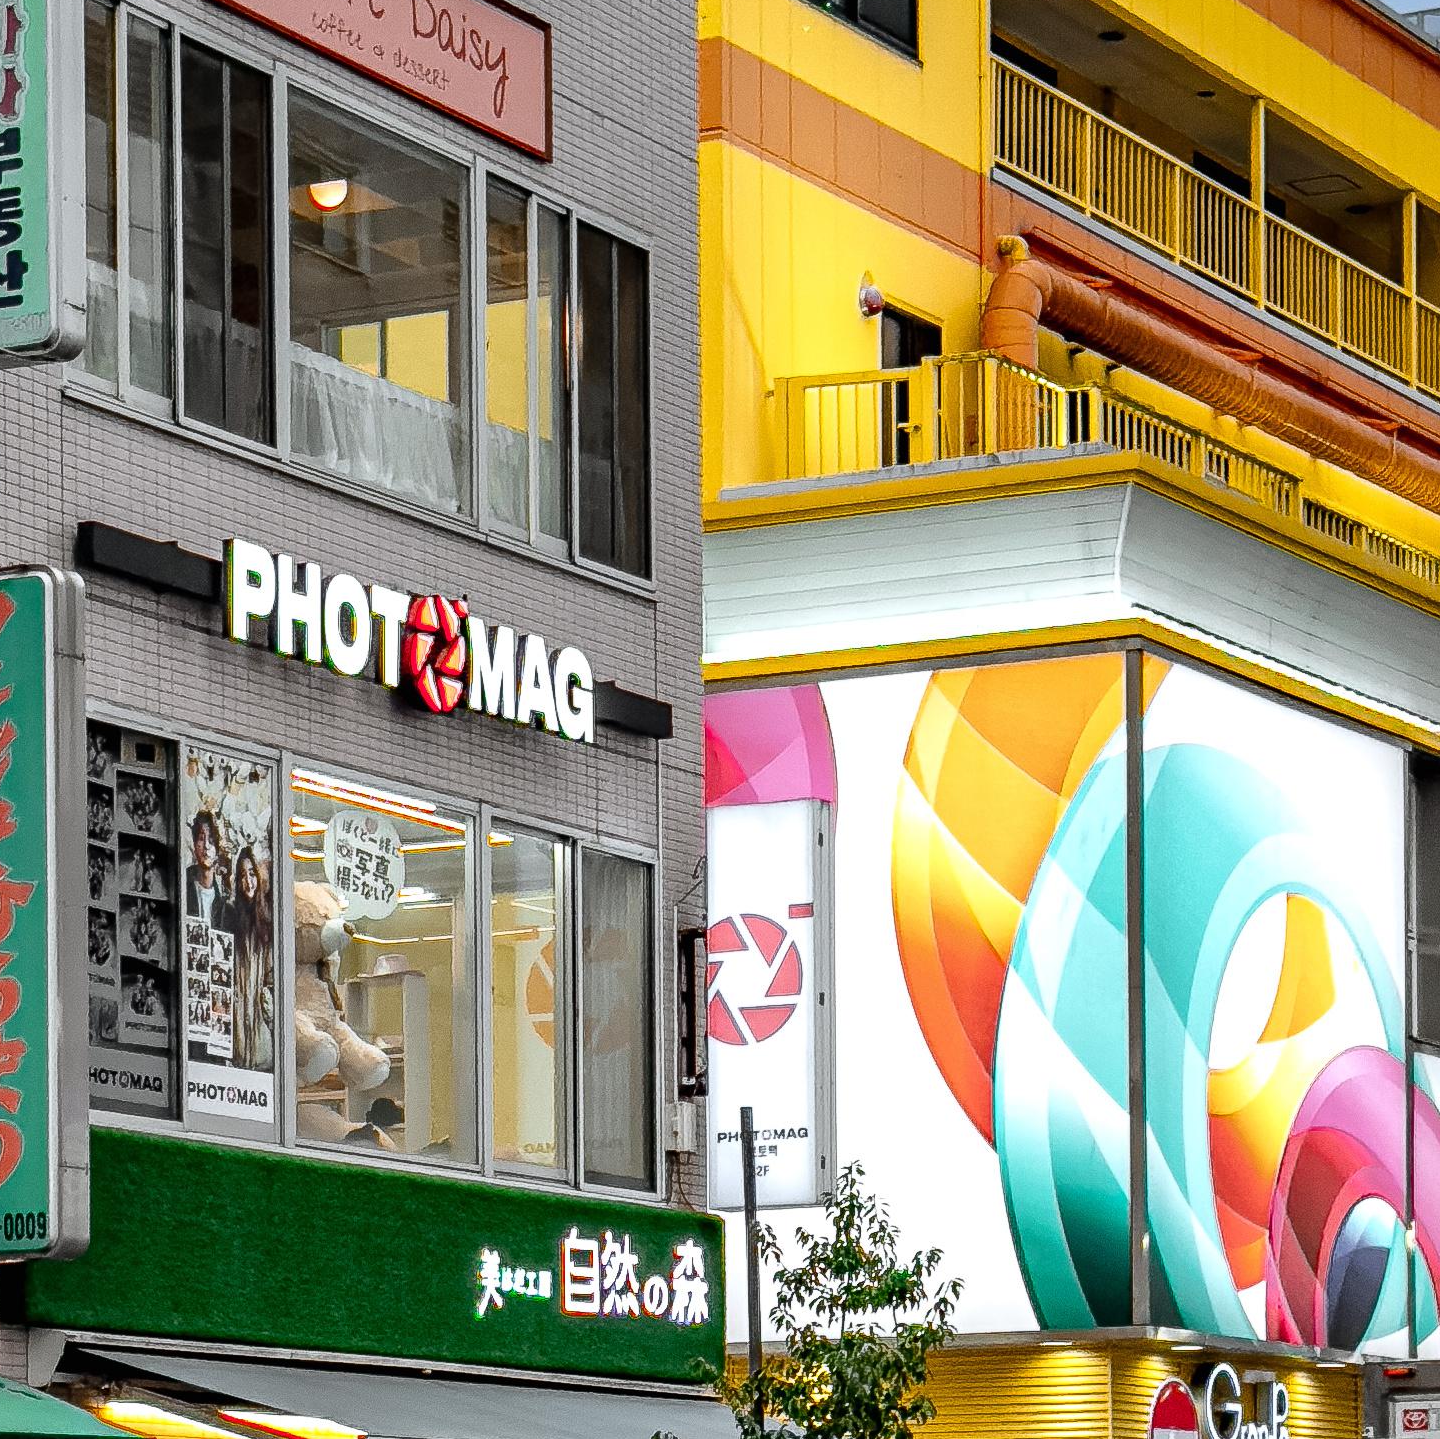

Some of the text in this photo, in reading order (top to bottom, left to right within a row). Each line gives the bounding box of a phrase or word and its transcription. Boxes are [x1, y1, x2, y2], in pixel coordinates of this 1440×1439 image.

[312, 10, 365, 52] coffee
[393, 46, 450, 92] dessert
[355, 848, 390, 884] 写真
[89, 1066, 164, 1093] HOTOMAG
[716, 1127, 809, 1143] PHTOMAG
[560, 1225, 710, 1325] 自然の森
